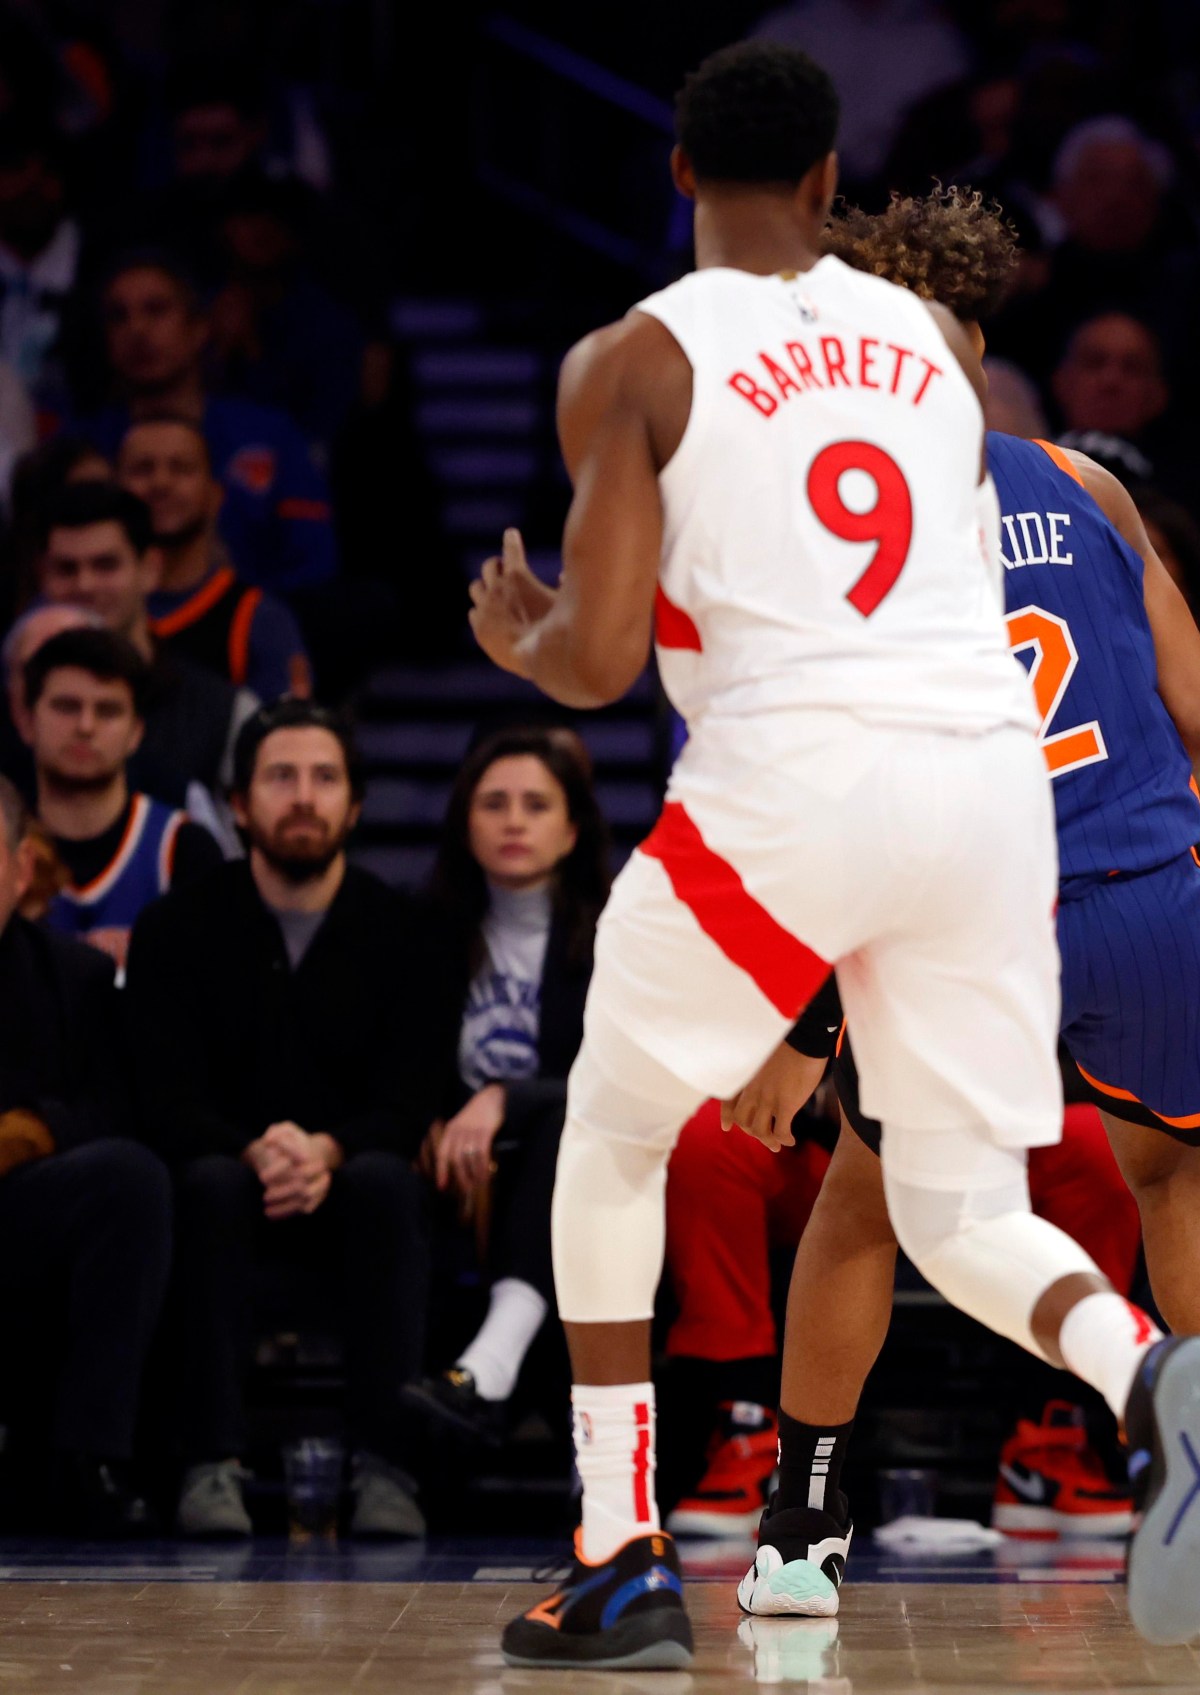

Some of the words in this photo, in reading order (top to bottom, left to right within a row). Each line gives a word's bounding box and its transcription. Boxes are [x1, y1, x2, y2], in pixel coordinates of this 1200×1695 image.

[727, 335, 943, 419] BARRETT
[804, 438, 913, 619] 9
[1000, 511, 1073, 570] IDE
[1001, 604, 1109, 780] 2
